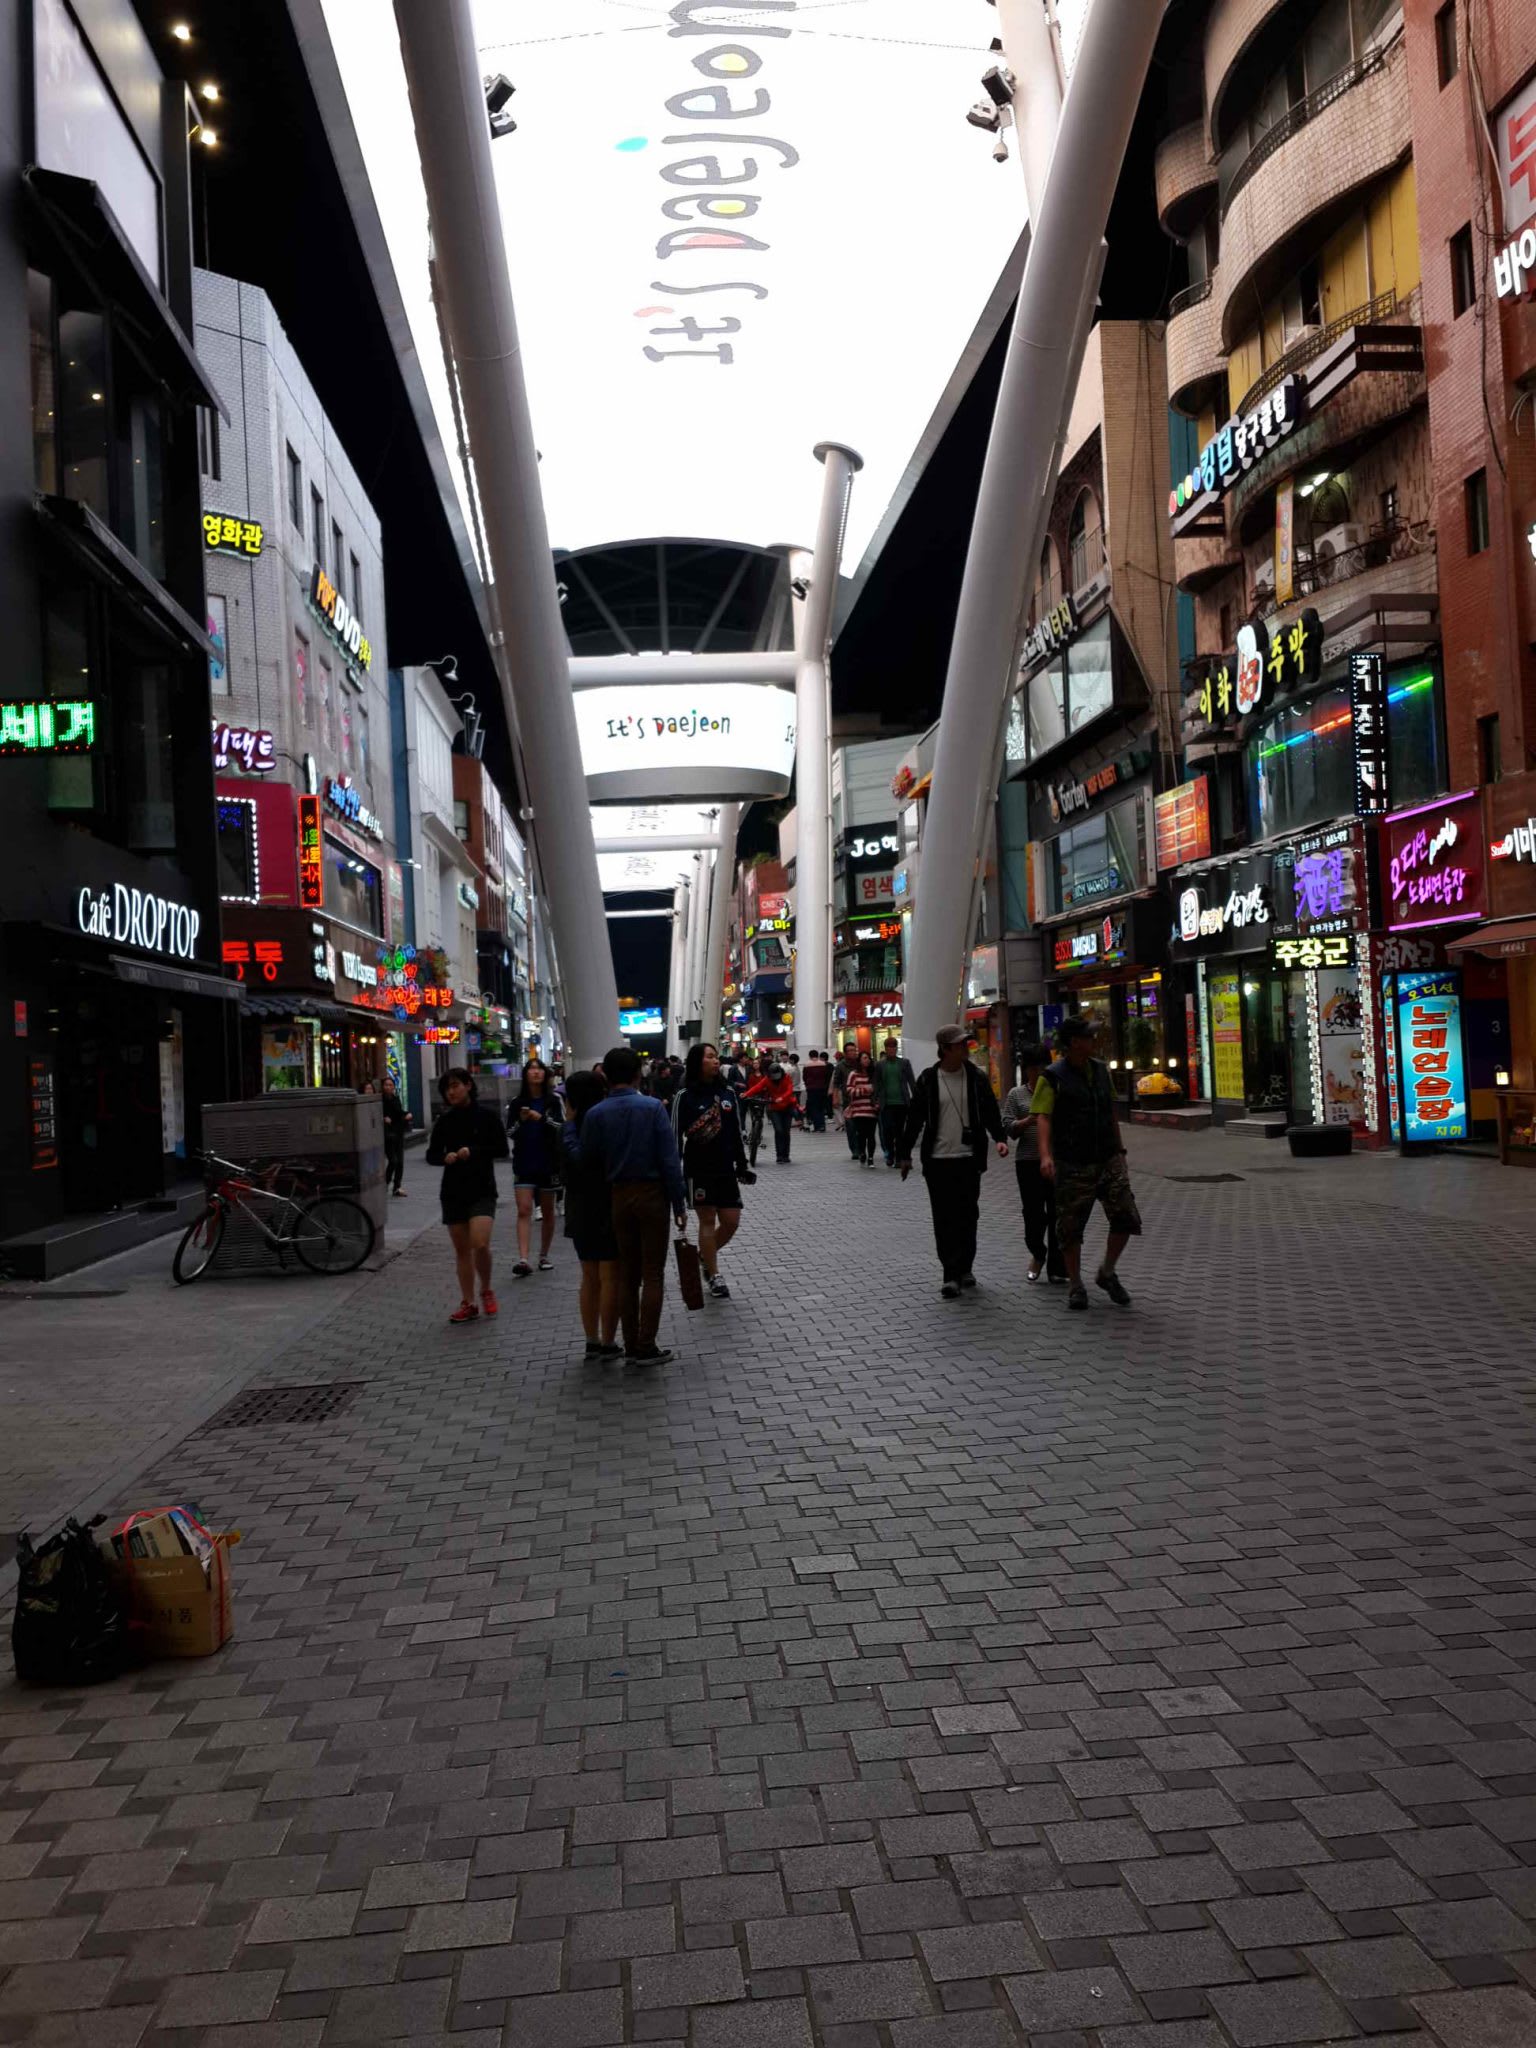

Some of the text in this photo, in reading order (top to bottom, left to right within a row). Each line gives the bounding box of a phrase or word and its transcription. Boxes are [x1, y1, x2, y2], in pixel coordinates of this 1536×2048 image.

[203, 514, 263, 555] 영화관
[333, 594, 361, 655] DVD
[607, 709, 731, 739] It's Daejeon
[1409, 866, 1466, 906] 노래연습장
[78, 883, 200, 960] Café DROPTOP
[1275, 938, 1350, 969] 주장군
[1407, 981, 1455, 1002] 오디션
[1411, 1004, 1454, 1122] 노래연습장
